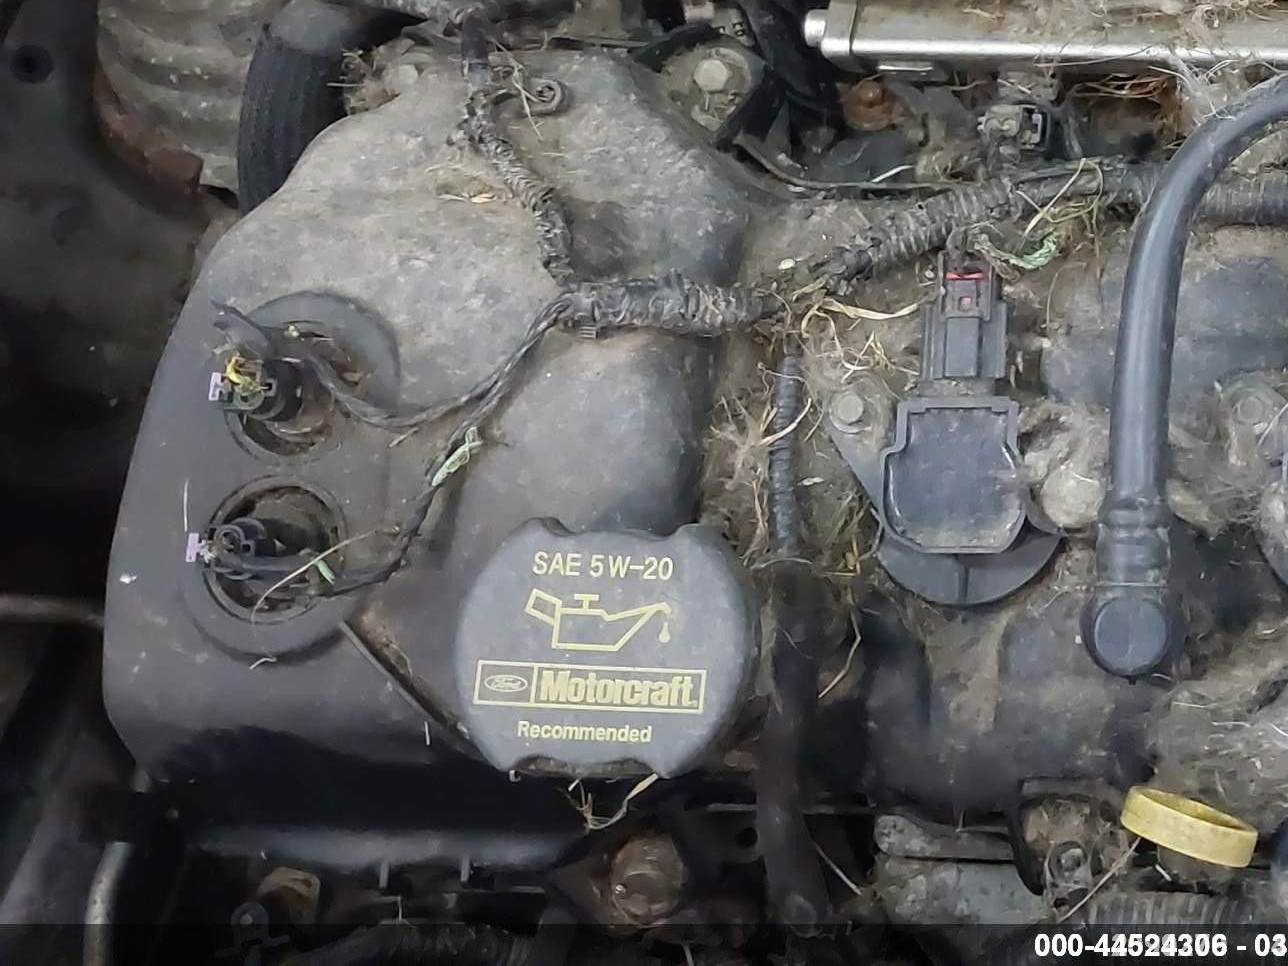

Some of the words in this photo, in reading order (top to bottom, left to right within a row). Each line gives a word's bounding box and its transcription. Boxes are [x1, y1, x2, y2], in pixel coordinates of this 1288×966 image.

[532, 551, 582, 577] SAE
[589, 554, 674, 580] 5W-20
[540, 669, 698, 707] Motorcraft
[517, 720, 652, 742] Recommended
